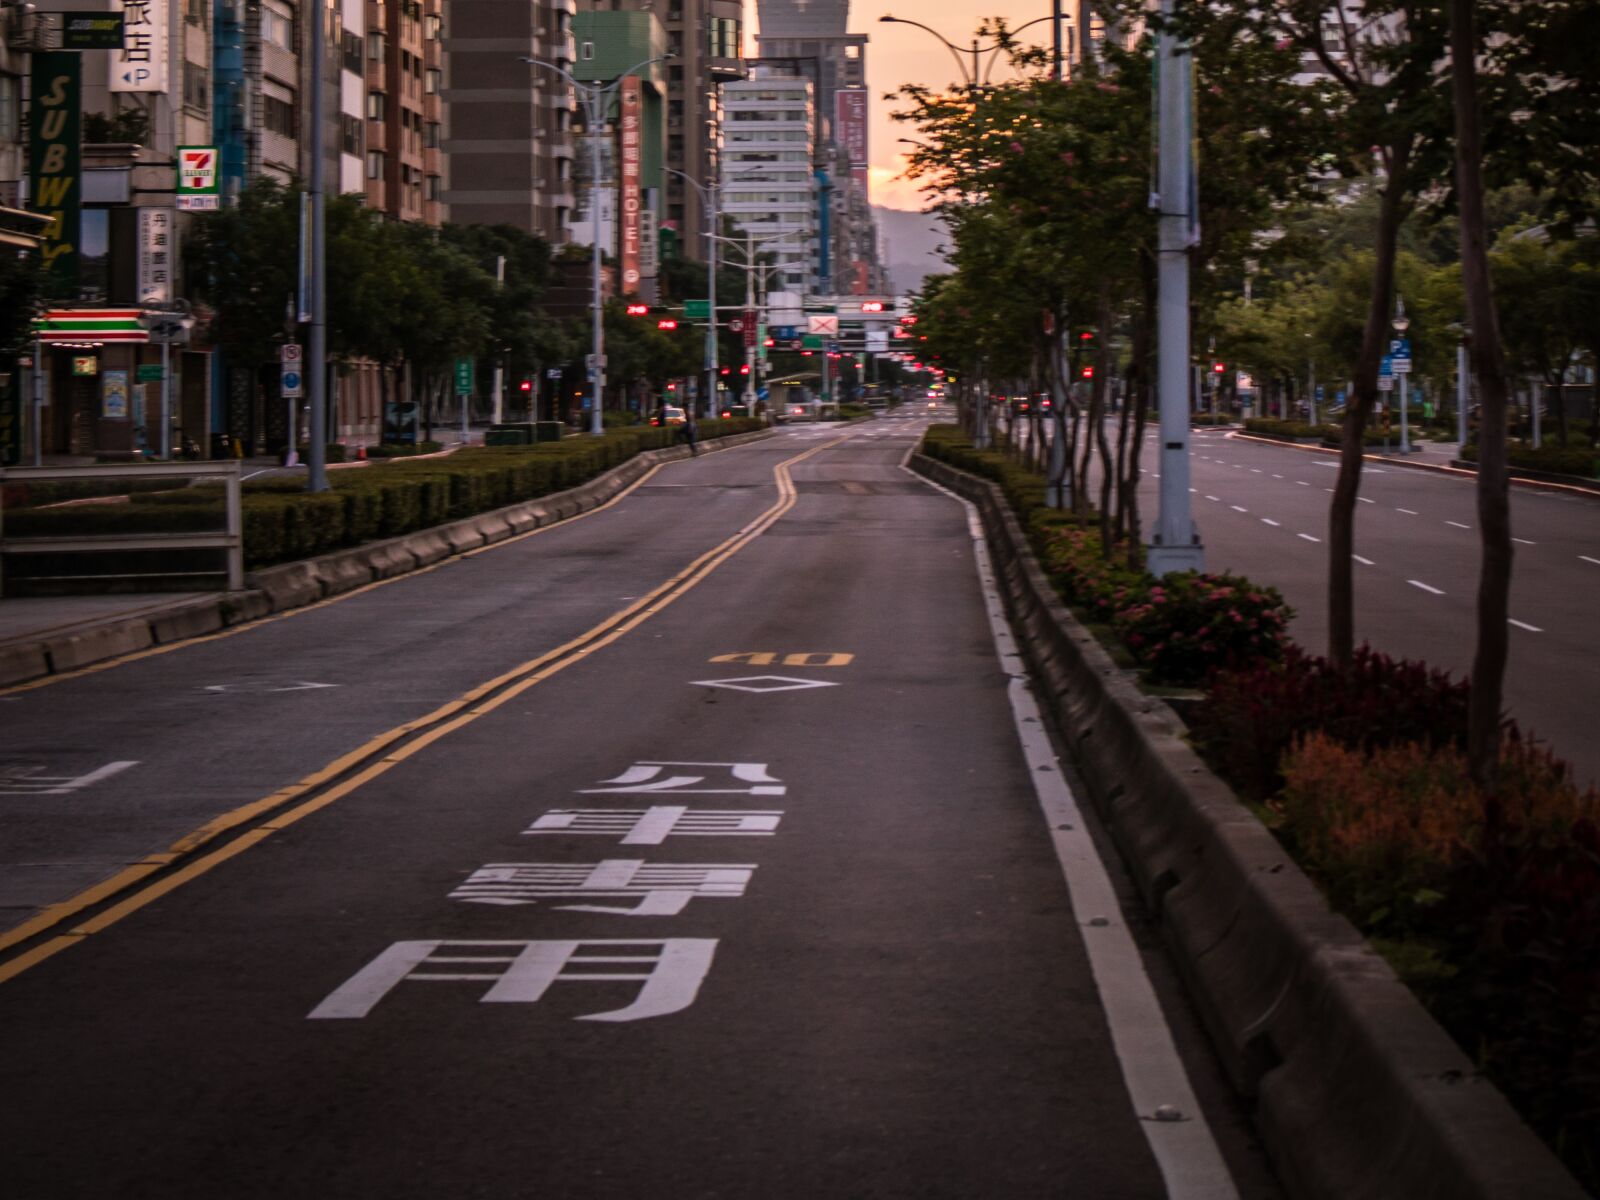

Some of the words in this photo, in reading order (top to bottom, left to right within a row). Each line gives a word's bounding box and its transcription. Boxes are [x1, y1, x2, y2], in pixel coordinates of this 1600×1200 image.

[135, 68, 151, 86] P
[36, 75, 74, 272] SUBWAY
[624, 184, 639, 254] HOTEL
[707, 651, 856, 666] 40
[305, 761, 787, 1023] 公車專用
